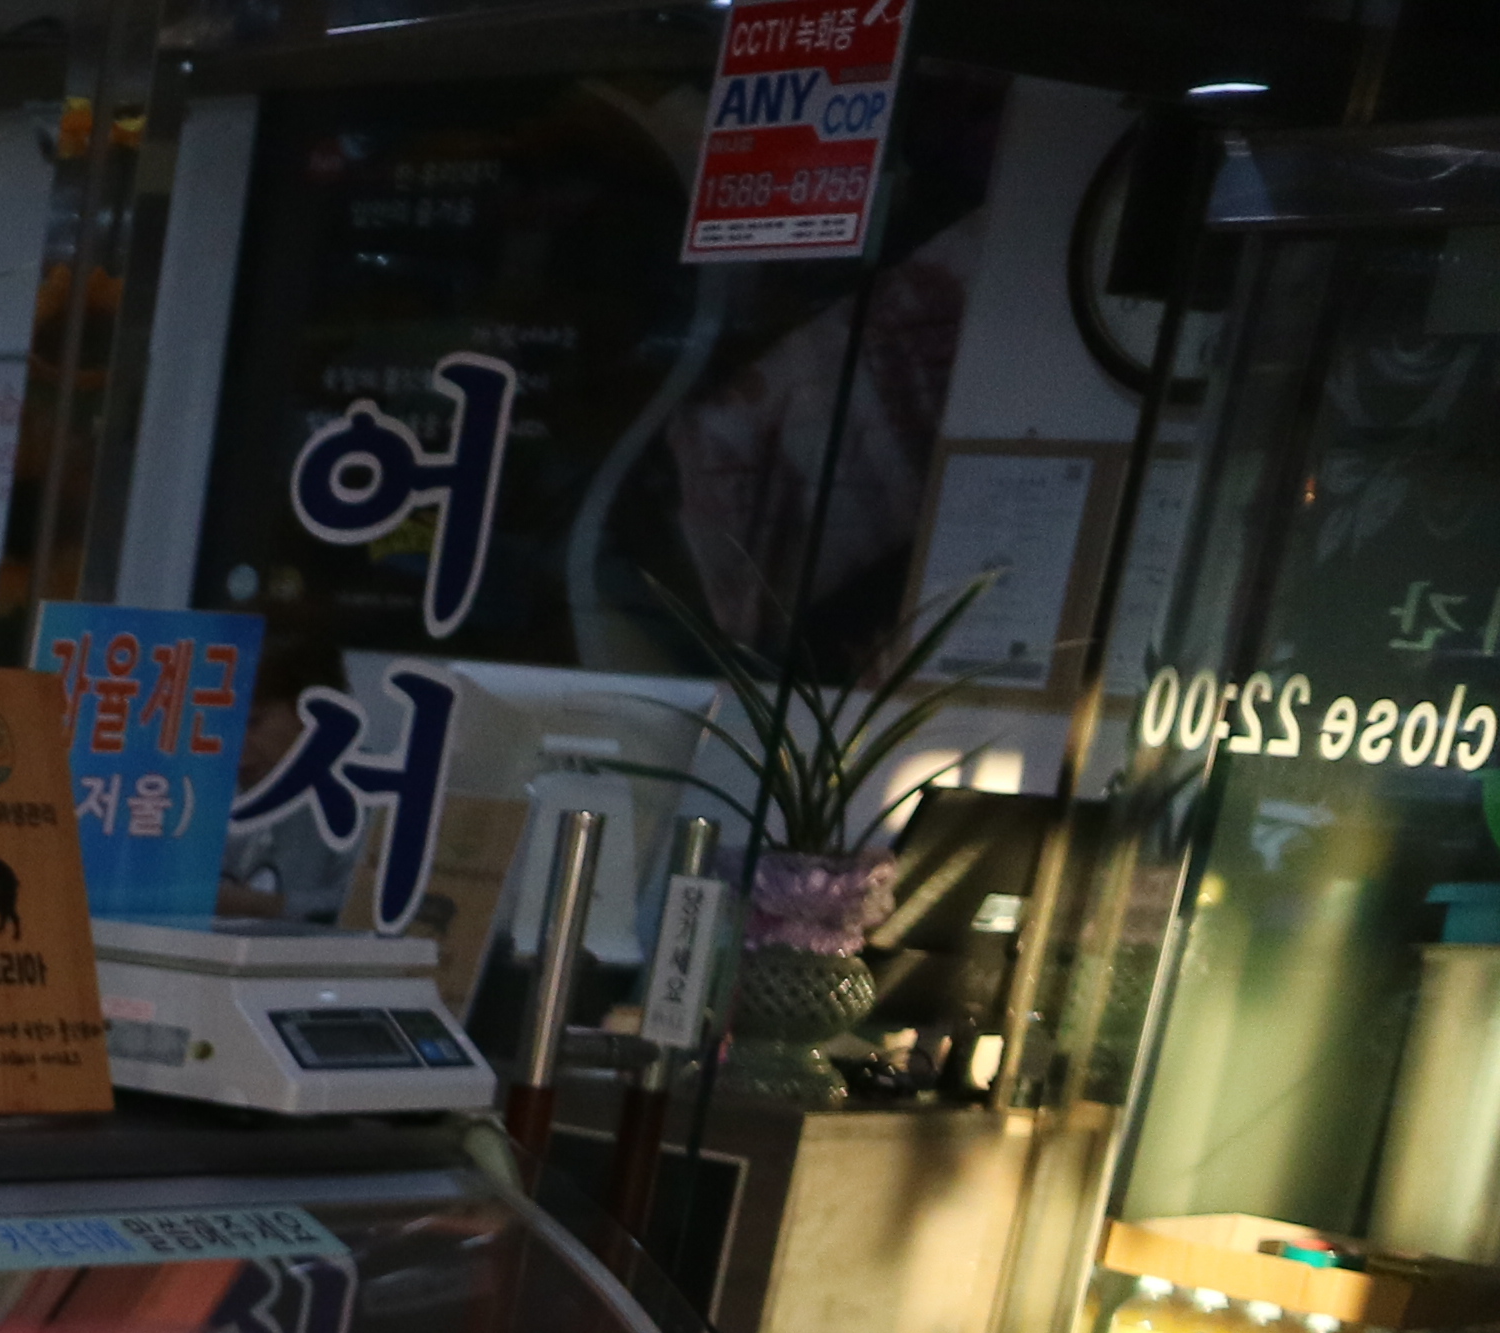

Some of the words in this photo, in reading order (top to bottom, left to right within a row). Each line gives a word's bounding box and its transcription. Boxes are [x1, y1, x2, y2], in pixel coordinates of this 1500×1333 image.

[731, 15, 792, 57] CCTV
[794, 7, 859, 53] 녹화중
[714, 70, 821, 127] ANY
[822, 90, 887, 134] COP
[704, 164, 869, 209] 1588-8755
[230, 352, 515, 936] 어서
